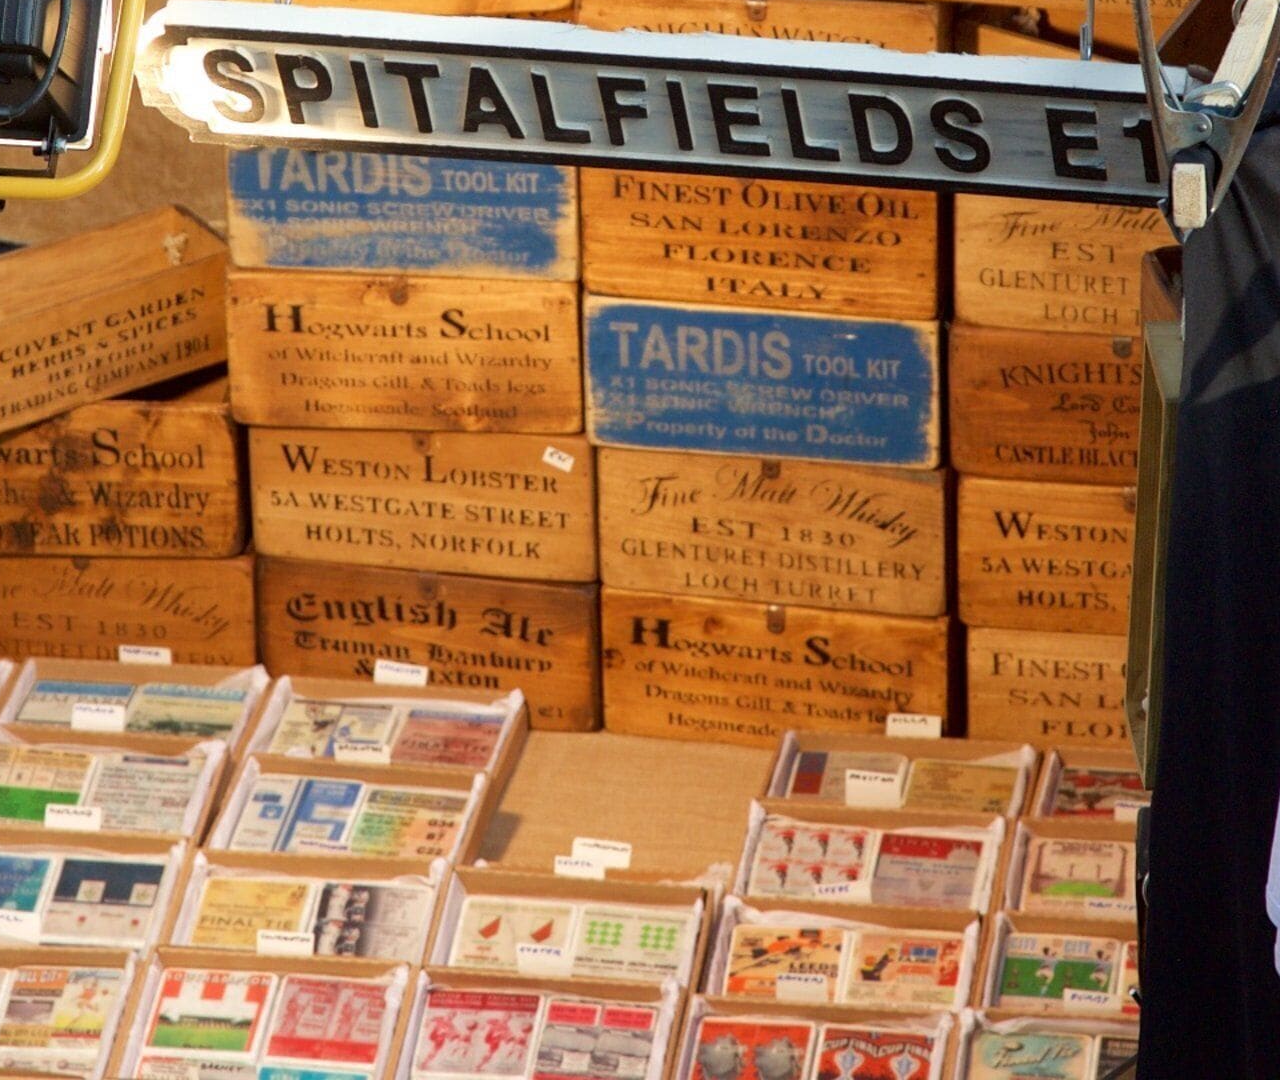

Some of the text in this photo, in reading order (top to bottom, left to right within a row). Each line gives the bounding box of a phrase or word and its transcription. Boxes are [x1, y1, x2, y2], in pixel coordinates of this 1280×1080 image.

[201, 49, 1162, 185] SPITALFIELDS E1
[256, 148, 538, 196] TARDIS TOOL KIT
[286, 200, 453, 217] SONIC SCREW
[630, 212, 901, 247] SAN LORENZO
[663, 243, 872, 274] FLORENCE
[707, 277, 828, 300] ITALY
[979, 268, 1129, 295] GLENTURET
[105, 286, 206, 329] GARDEN
[263, 303, 550, 341] Hogwarts School
[1044, 304, 1117, 325] LOCH
[10, 308, 199, 378] HERBS SPICES
[610, 322, 901, 380] TARDIS TOOL KIT
[48, 342, 155, 382] BEDFORD
[85, 350, 169, 391] COMPANY
[625, 412, 888, 447] Property the Doctor
[92, 427, 205, 468] School
[87, 482, 210, 511] Wizardry
[270, 491, 570, 529] 5A WESTGATE STREET
[90, 523, 206, 550] POTIONS
[411, 532, 541, 559] NORFOLK
[692, 517, 857, 548] EST 1830
[779, 552, 927, 581] DISTILLERY
[982, 556, 1012, 576] 5A
[685, 572, 758, 595] LOCH
[13, 612, 168, 640] EST 1830
[286, 593, 554, 647] English Ale
[631, 617, 914, 677] Hogwarts School
[1009, 688, 1086, 710] SAN
[199, 915, 255, 927] FINAL
